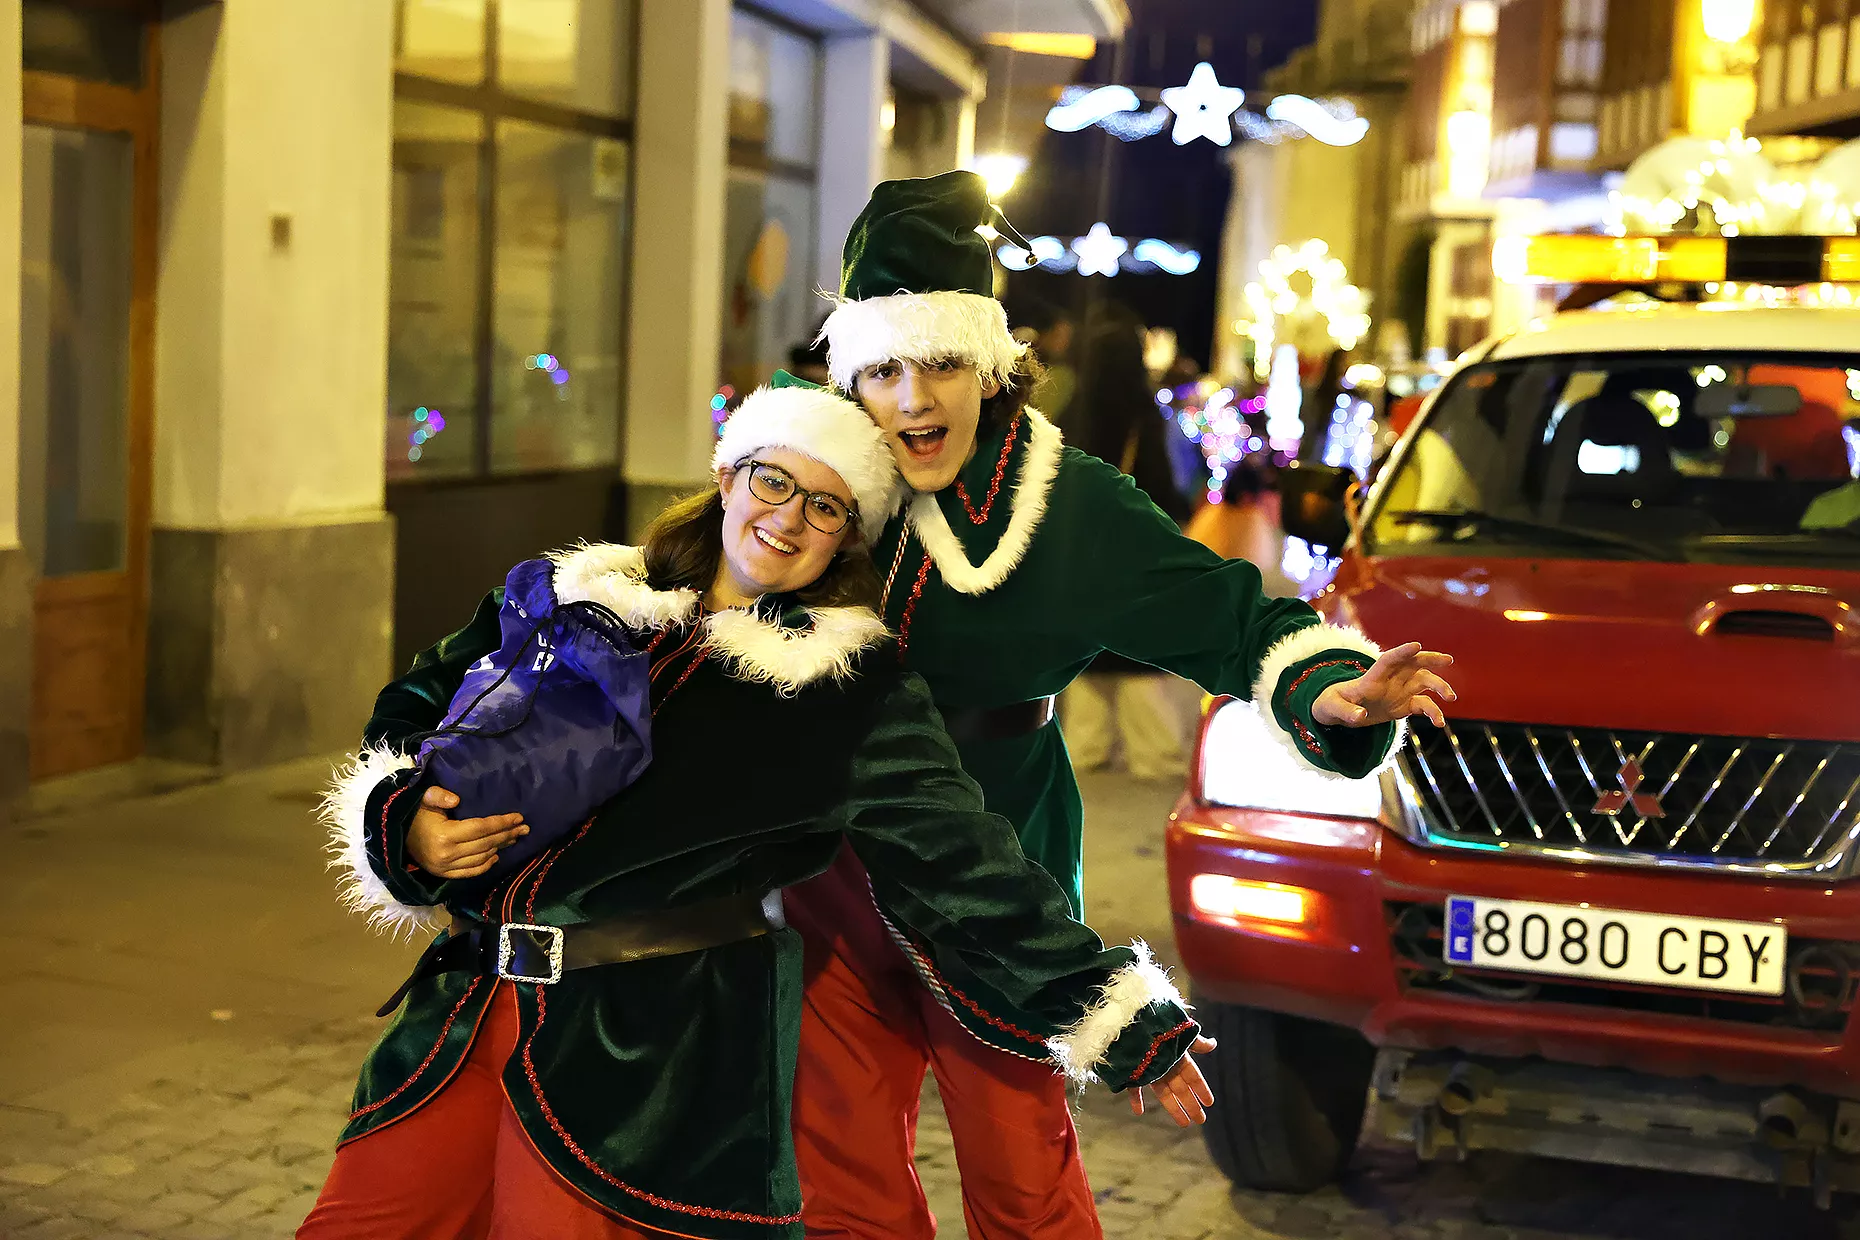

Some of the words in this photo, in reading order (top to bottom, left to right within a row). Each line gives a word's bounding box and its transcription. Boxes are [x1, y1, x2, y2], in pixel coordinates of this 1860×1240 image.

[1454, 936, 1469, 953] E
[1482, 909, 1629, 969] 8080
[1657, 927, 1770, 983] CBY
